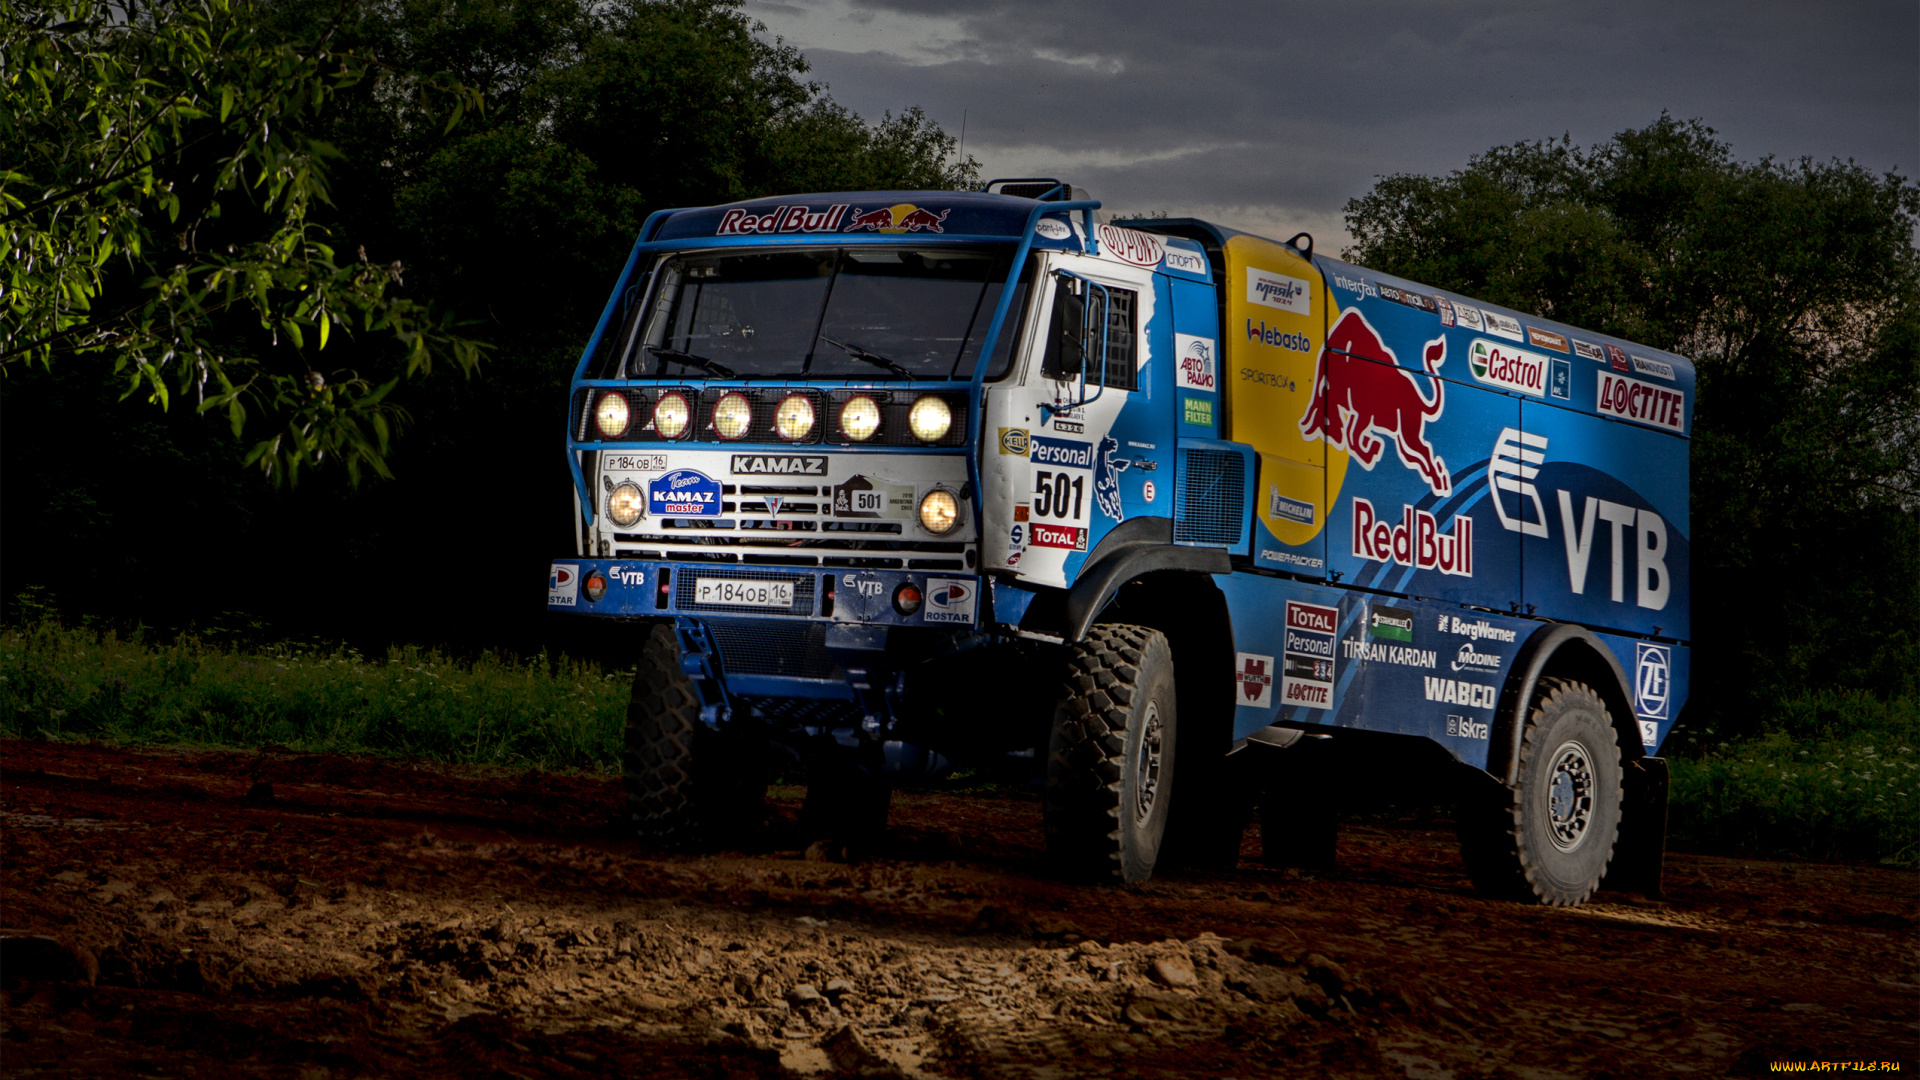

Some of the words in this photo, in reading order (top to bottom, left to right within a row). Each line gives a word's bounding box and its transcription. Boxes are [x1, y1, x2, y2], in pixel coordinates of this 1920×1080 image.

[716, 206, 787, 235] Red
[778, 203, 850, 232] Bull
[1332, 273, 1378, 301] interfax
[1246, 318, 1311, 353] Webasto
[1180, 357, 1203, 373] АВТО
[1488, 348, 1542, 390] Castrol
[1187, 371, 1214, 388] РАДИО
[1185, 399, 1212, 413] MANN
[1600, 376, 1682, 427] LOCTITE
[1185, 411, 1212, 425] FILTER
[1030, 440, 1092, 466] Personal
[732, 455, 823, 474] KAMAZ
[668, 472, 701, 490] Team
[653, 490, 715, 503] KAMAZ
[858, 493, 881, 509] 501
[1035, 471, 1084, 520] 501
[1146, 484, 1153, 499] E
[665, 503, 704, 514] master
[1279, 500, 1313, 519] MICHELIN
[1035, 527, 1075, 545] TOTAL
[1352, 496, 1413, 567] Red
[1416, 509, 1473, 577] Bull
[1556, 488, 1670, 611] VTB
[620, 571, 645, 585] VTB
[857, 580, 883, 595] VTB
[926, 611, 970, 623] ROSTAR
[1291, 606, 1333, 630] TOTAL
[1451, 616, 1517, 642] BorgWarner
[1287, 632, 1333, 656] Personal
[1389, 645, 1437, 669] KARDAN
[1458, 651, 1501, 667] MODINE
[1641, 661, 1667, 701] ZF
[1287, 683, 1328, 703] LOCTITE
[1424, 675, 1496, 710] WABCO
[1458, 716, 1488, 740] Iskra
